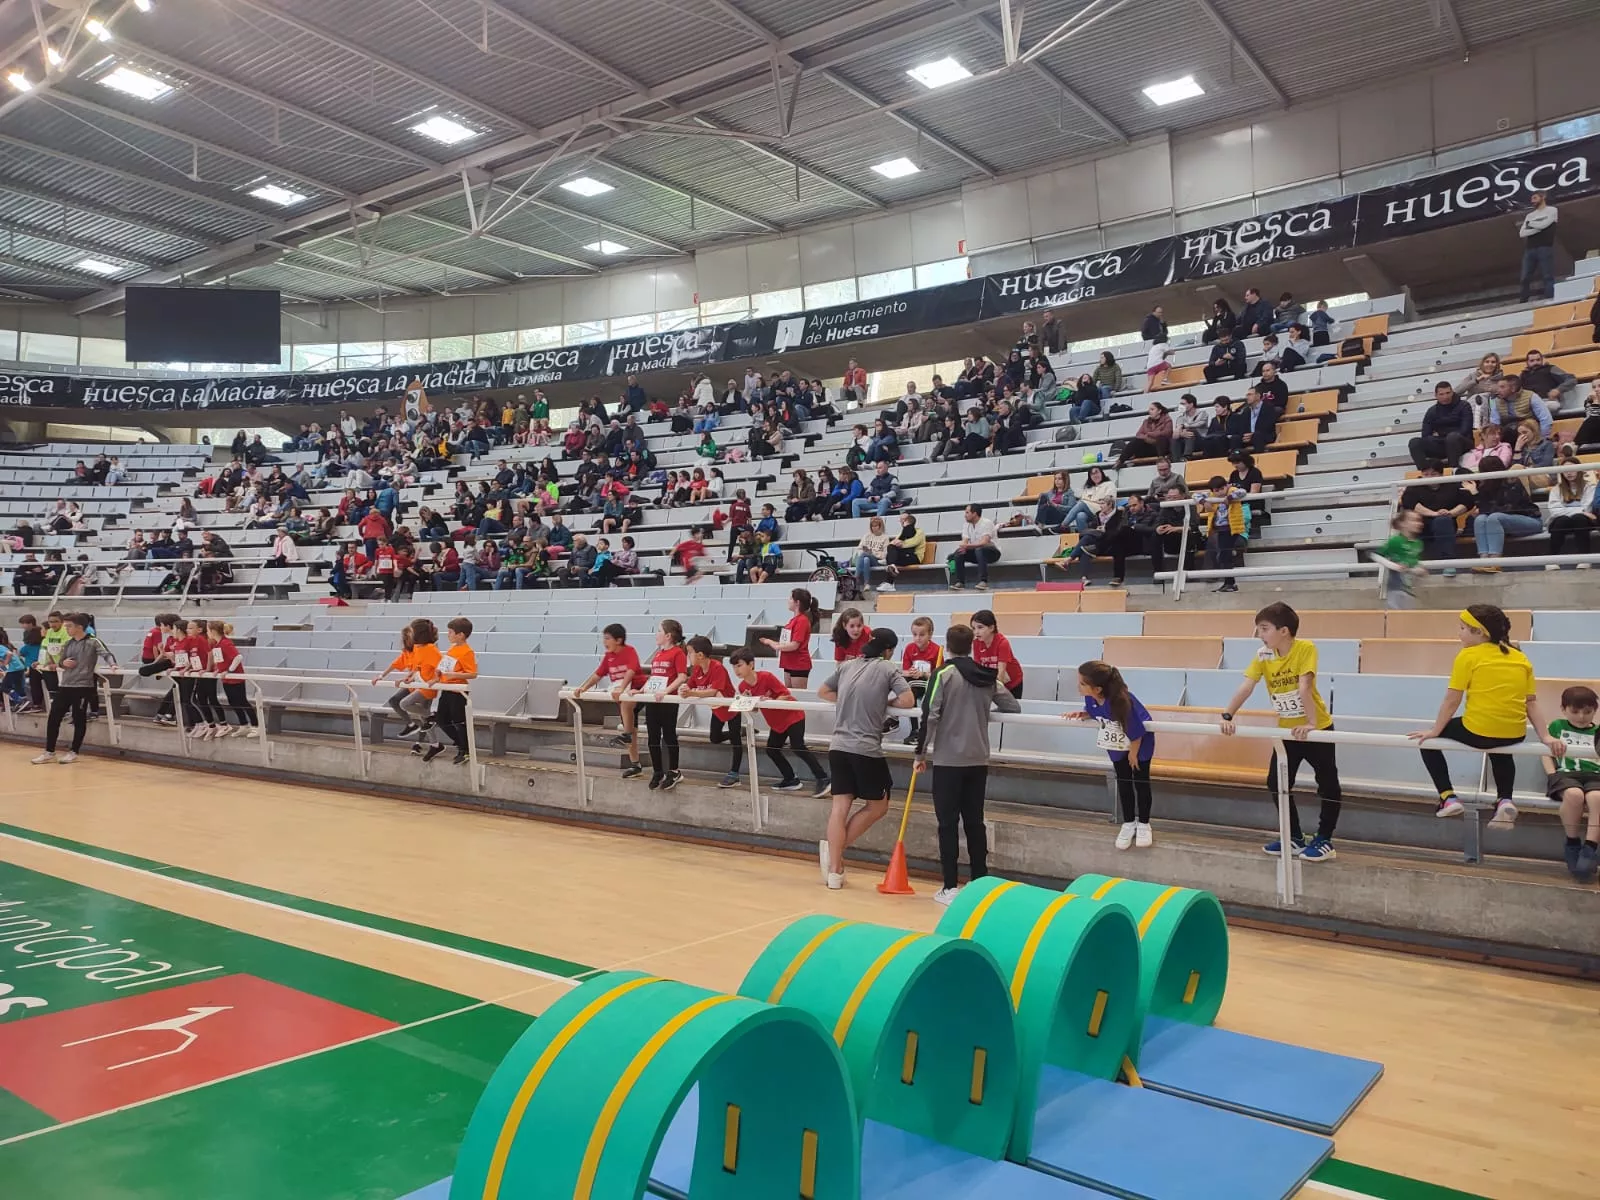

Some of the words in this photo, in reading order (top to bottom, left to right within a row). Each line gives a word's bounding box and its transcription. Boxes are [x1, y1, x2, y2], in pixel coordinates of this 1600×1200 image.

[809, 301, 907, 330] Ayuntamiento
[805, 331, 822, 345] de
[826, 323, 880, 342] Huesca
[1103, 731, 1126, 743] 382
